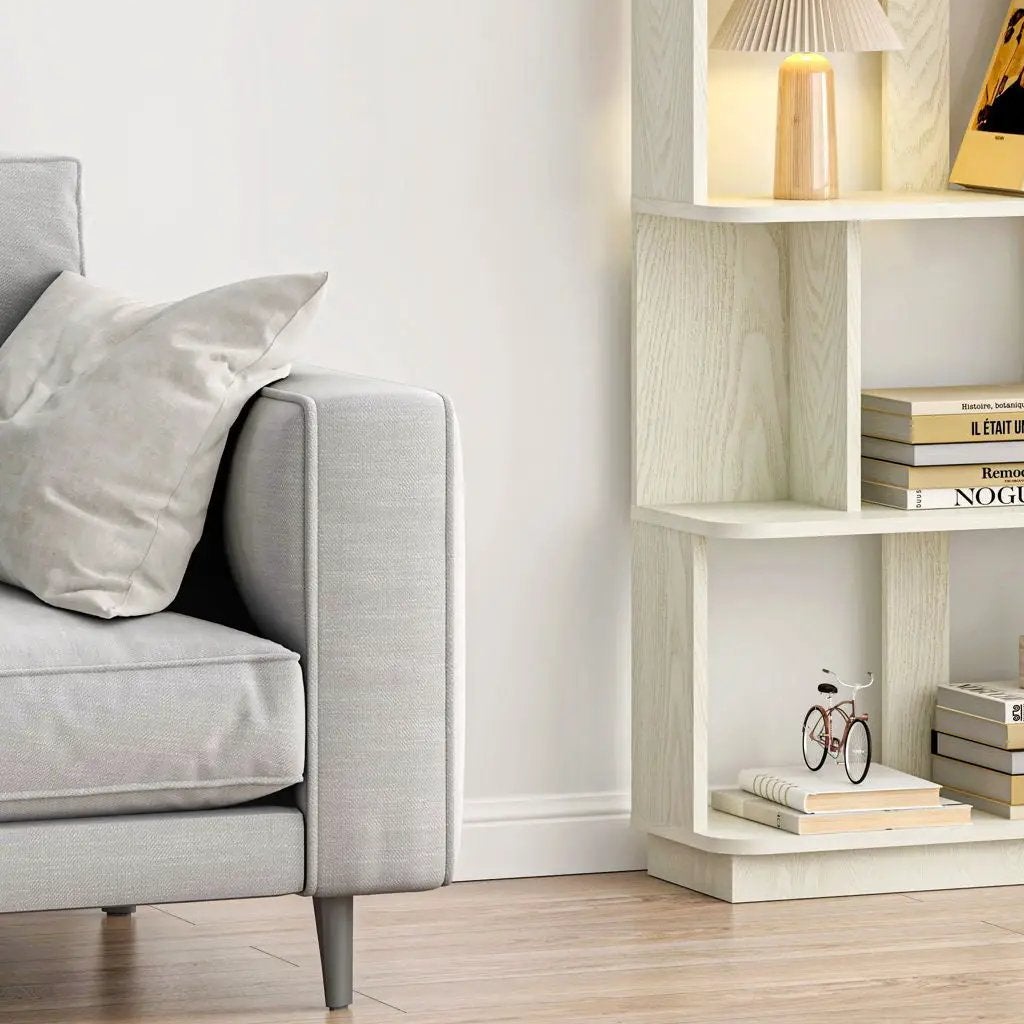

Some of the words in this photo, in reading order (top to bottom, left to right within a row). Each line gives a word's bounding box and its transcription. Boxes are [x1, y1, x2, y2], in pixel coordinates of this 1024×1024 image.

[961, 402, 993, 410] Histoire,
[971, 422, 981, 436] IL
[984, 418, 1012, 435] ÉTAIT
